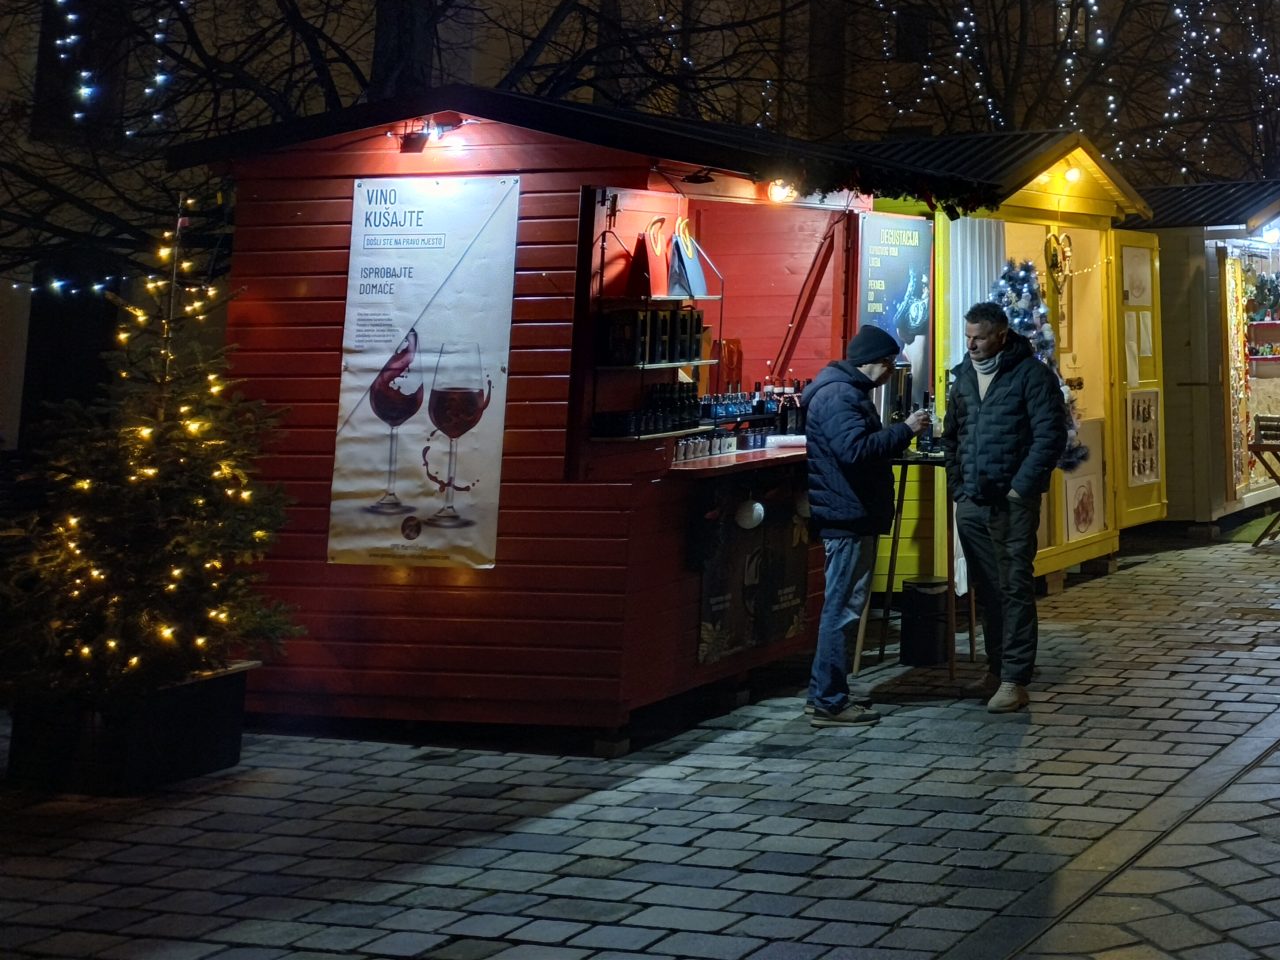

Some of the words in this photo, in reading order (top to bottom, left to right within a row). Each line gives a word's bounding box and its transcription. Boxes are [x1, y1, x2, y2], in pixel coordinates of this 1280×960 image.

[367, 189, 396, 205] VINO
[365, 207, 424, 227] KUŠAJTE
[881, 229, 919, 246] DEGUSTACIJA
[360, 267, 413, 279] ISPROBAJTE
